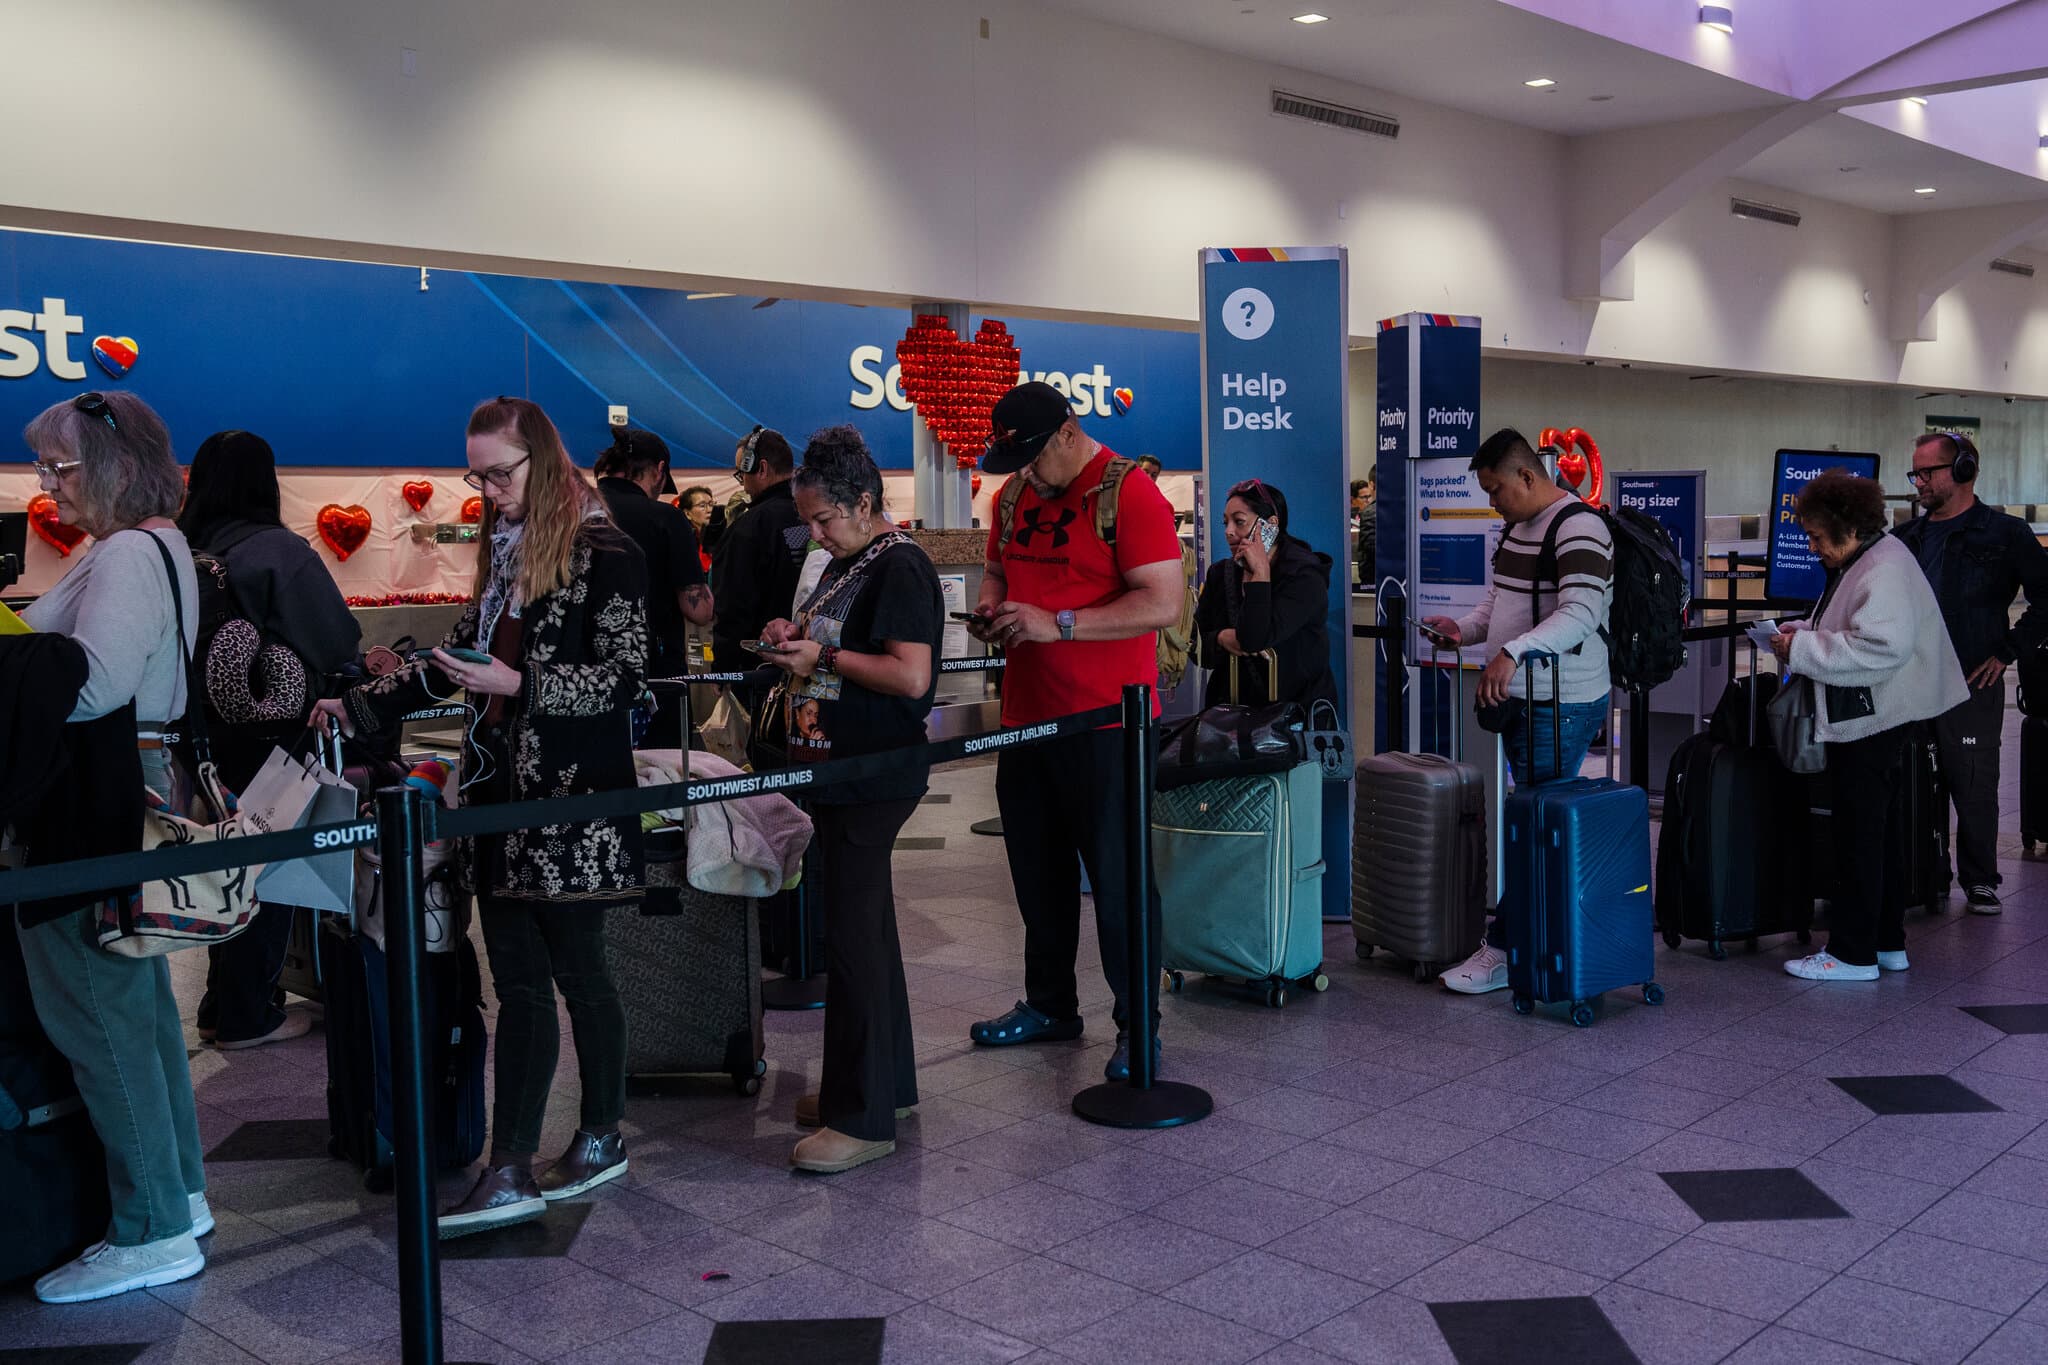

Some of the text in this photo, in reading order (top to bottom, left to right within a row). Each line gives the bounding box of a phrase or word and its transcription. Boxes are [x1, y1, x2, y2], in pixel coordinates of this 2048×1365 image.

[1222, 372, 1287, 403] Help
[1223, 406, 1293, 430] Desk
[1380, 408, 1407, 430] Priority
[1428, 406, 1474, 430] Priority
[1380, 434, 1397, 451] Lane
[1428, 432, 1458, 449] Lane
[1420, 476, 1466, 488] Bags packed?
[1622, 481, 1655, 489] Southwest
[1420, 489, 1471, 499] What to know.
[1621, 493, 1680, 510] Bag sizer
[1778, 532, 1798, 541] A-List
[1776, 561, 1811, 570] Customers
[1777, 553, 1805, 561] Business
[941, 660, 984, 671] SOUTHWEST
[703, 672, 744, 681] AIRLINES
[965, 723, 1059, 753] SOUTHWEST AIRLINES
[687, 769, 814, 800] SOUTHWEST AIRLINES
